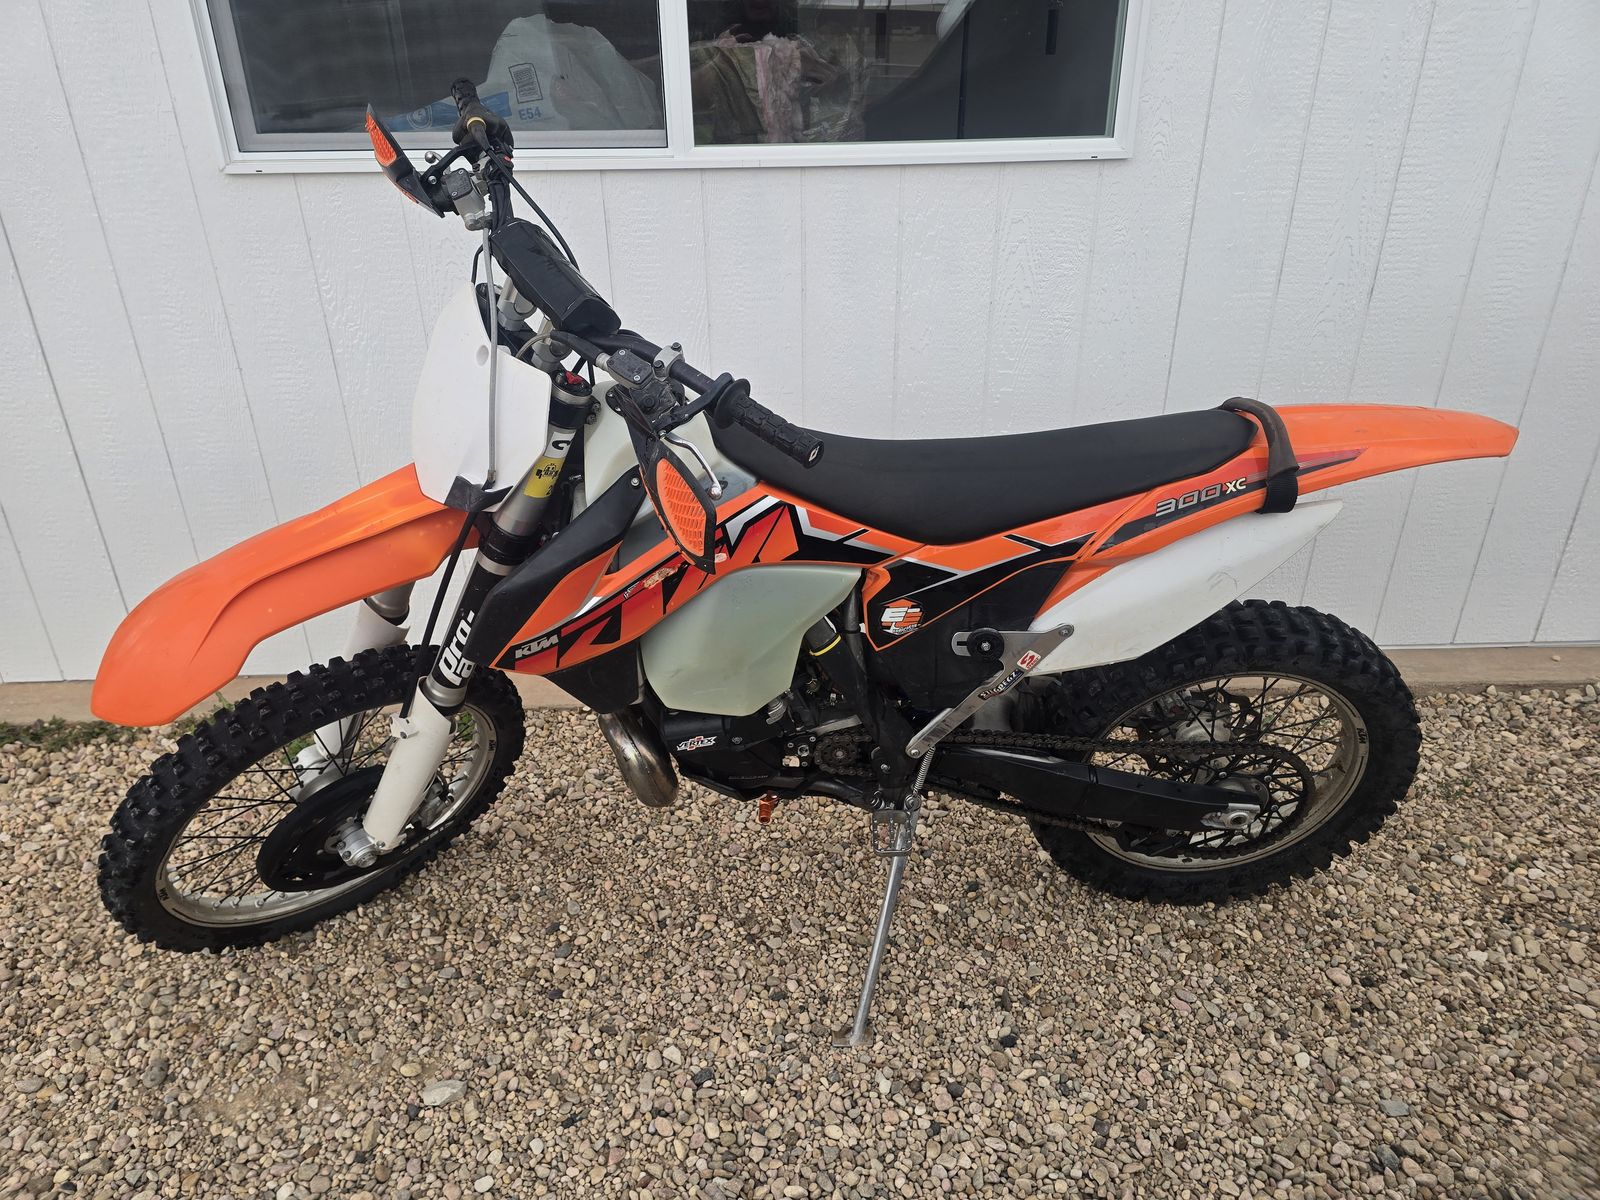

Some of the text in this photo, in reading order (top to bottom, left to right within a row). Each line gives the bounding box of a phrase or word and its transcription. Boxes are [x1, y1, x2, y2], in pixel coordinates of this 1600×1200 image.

[519, 106, 541, 120] E54
[1155, 477, 1247, 517] 300 XC
[515, 634, 559, 659] KTM
[677, 736, 717, 751] VERTEX
